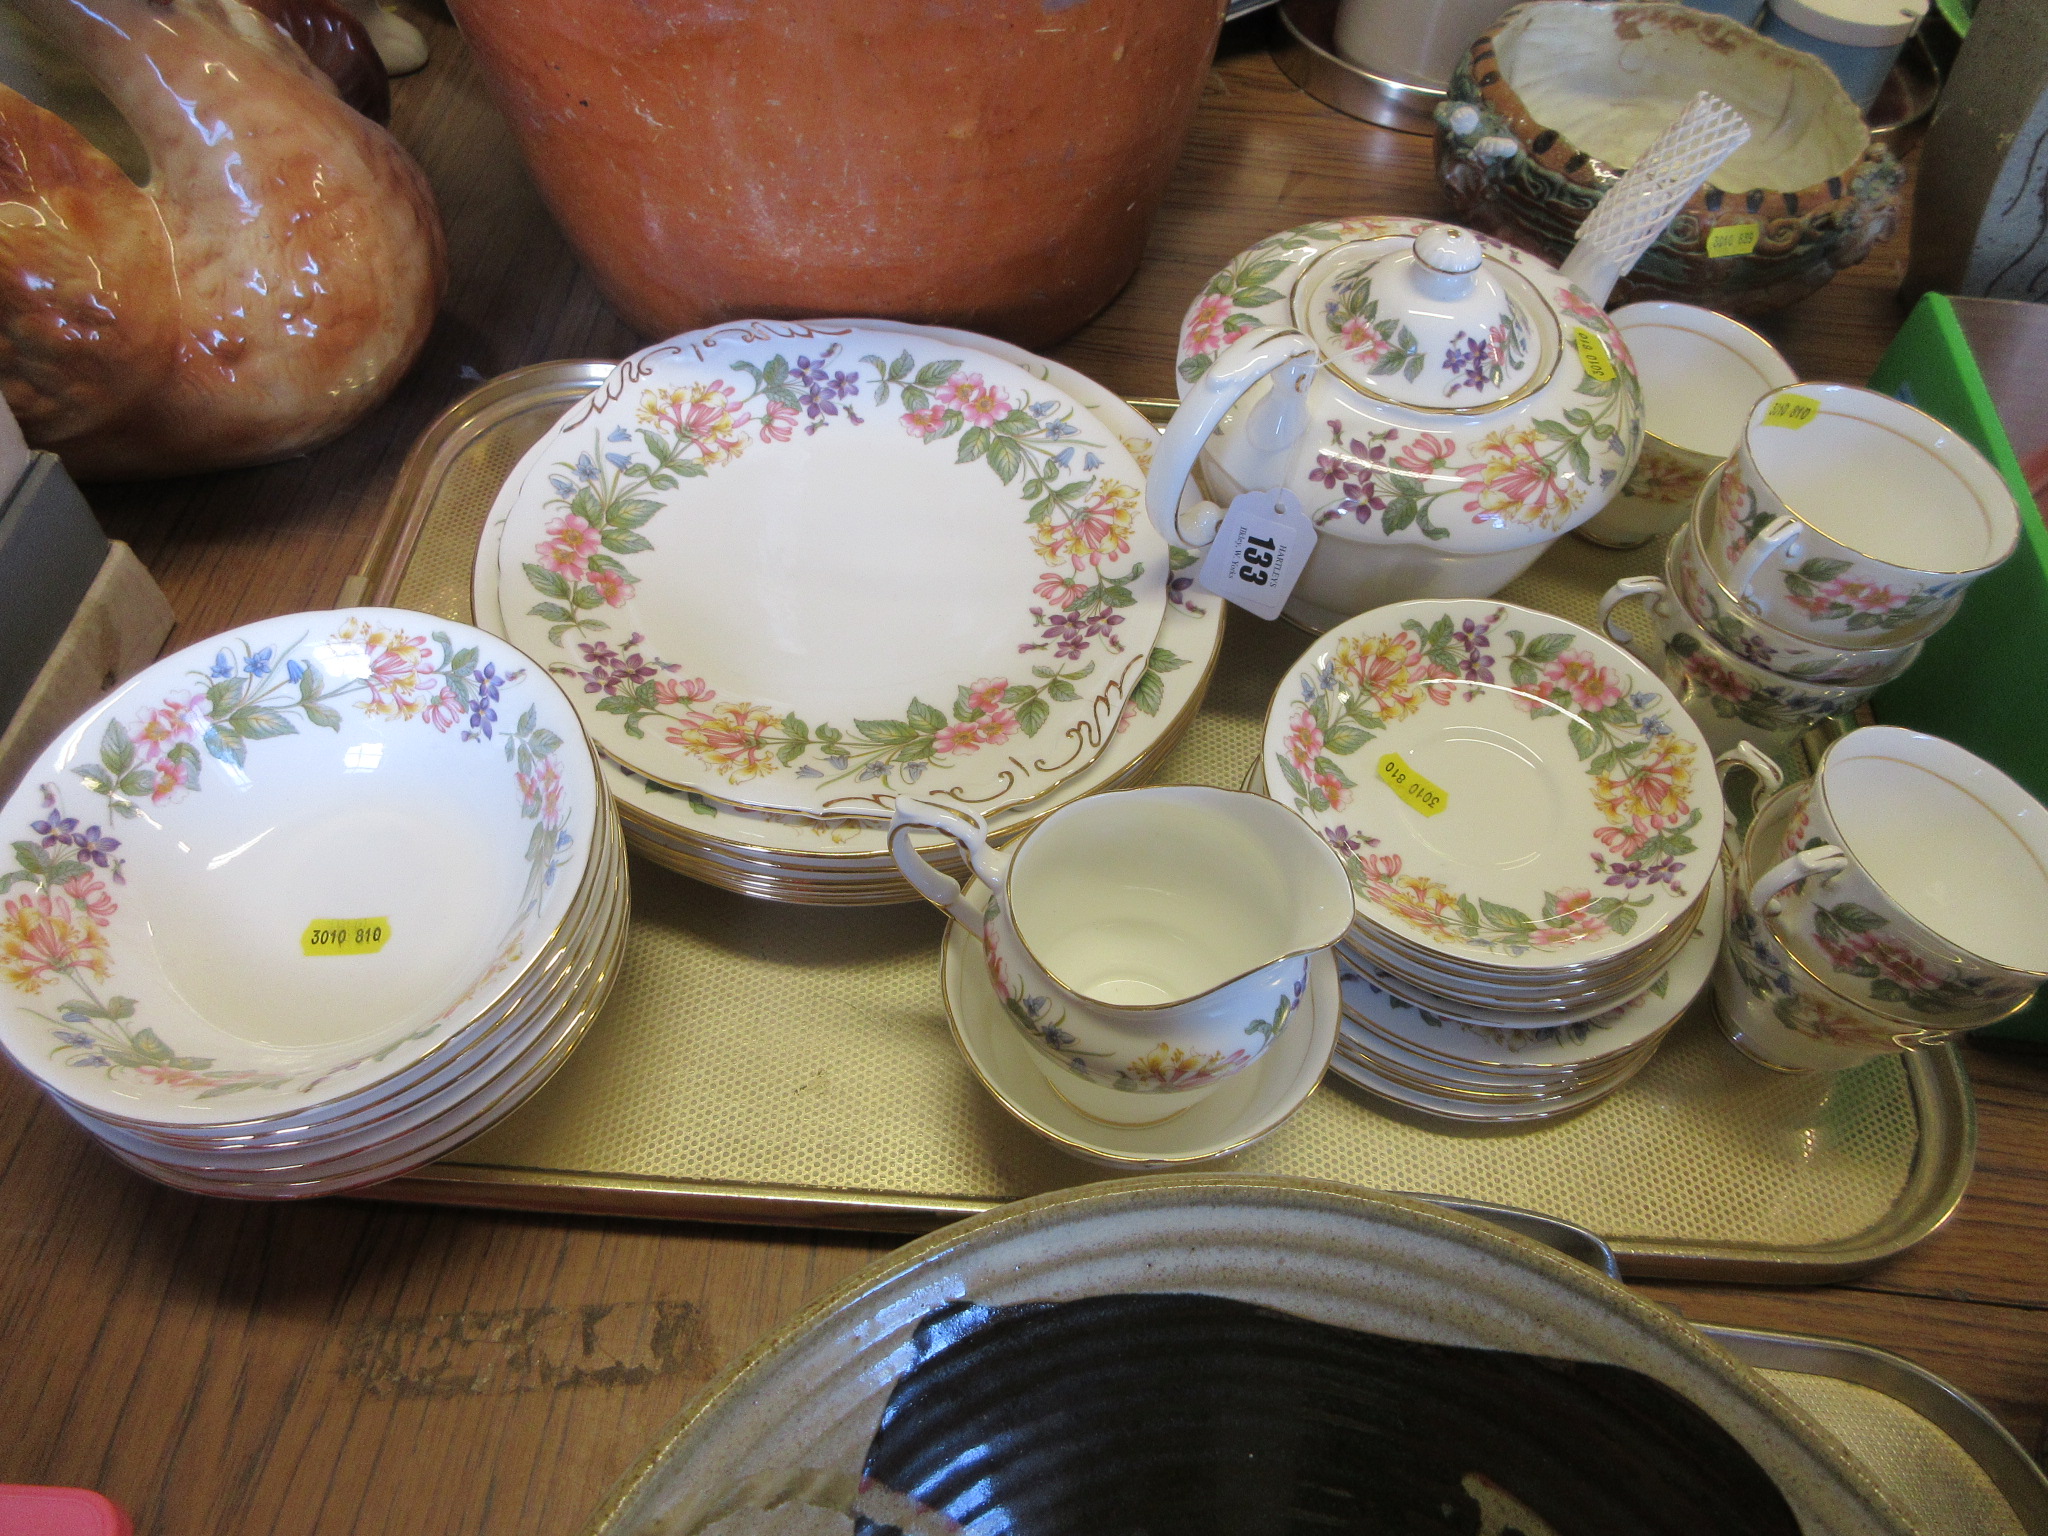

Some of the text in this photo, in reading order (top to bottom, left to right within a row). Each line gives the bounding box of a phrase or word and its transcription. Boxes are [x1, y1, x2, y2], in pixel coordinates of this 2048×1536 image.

[1578, 333, 1605, 376] 3010 810
[1789, 405, 1811, 420] 810
[1228, 560, 1239, 579] Yorks
[1238, 535, 1276, 586] 133
[1270, 545, 1288, 588] HARTLEYS
[1385, 761, 1440, 809] 3010 810
[311, 926, 382, 946] 3010 810
